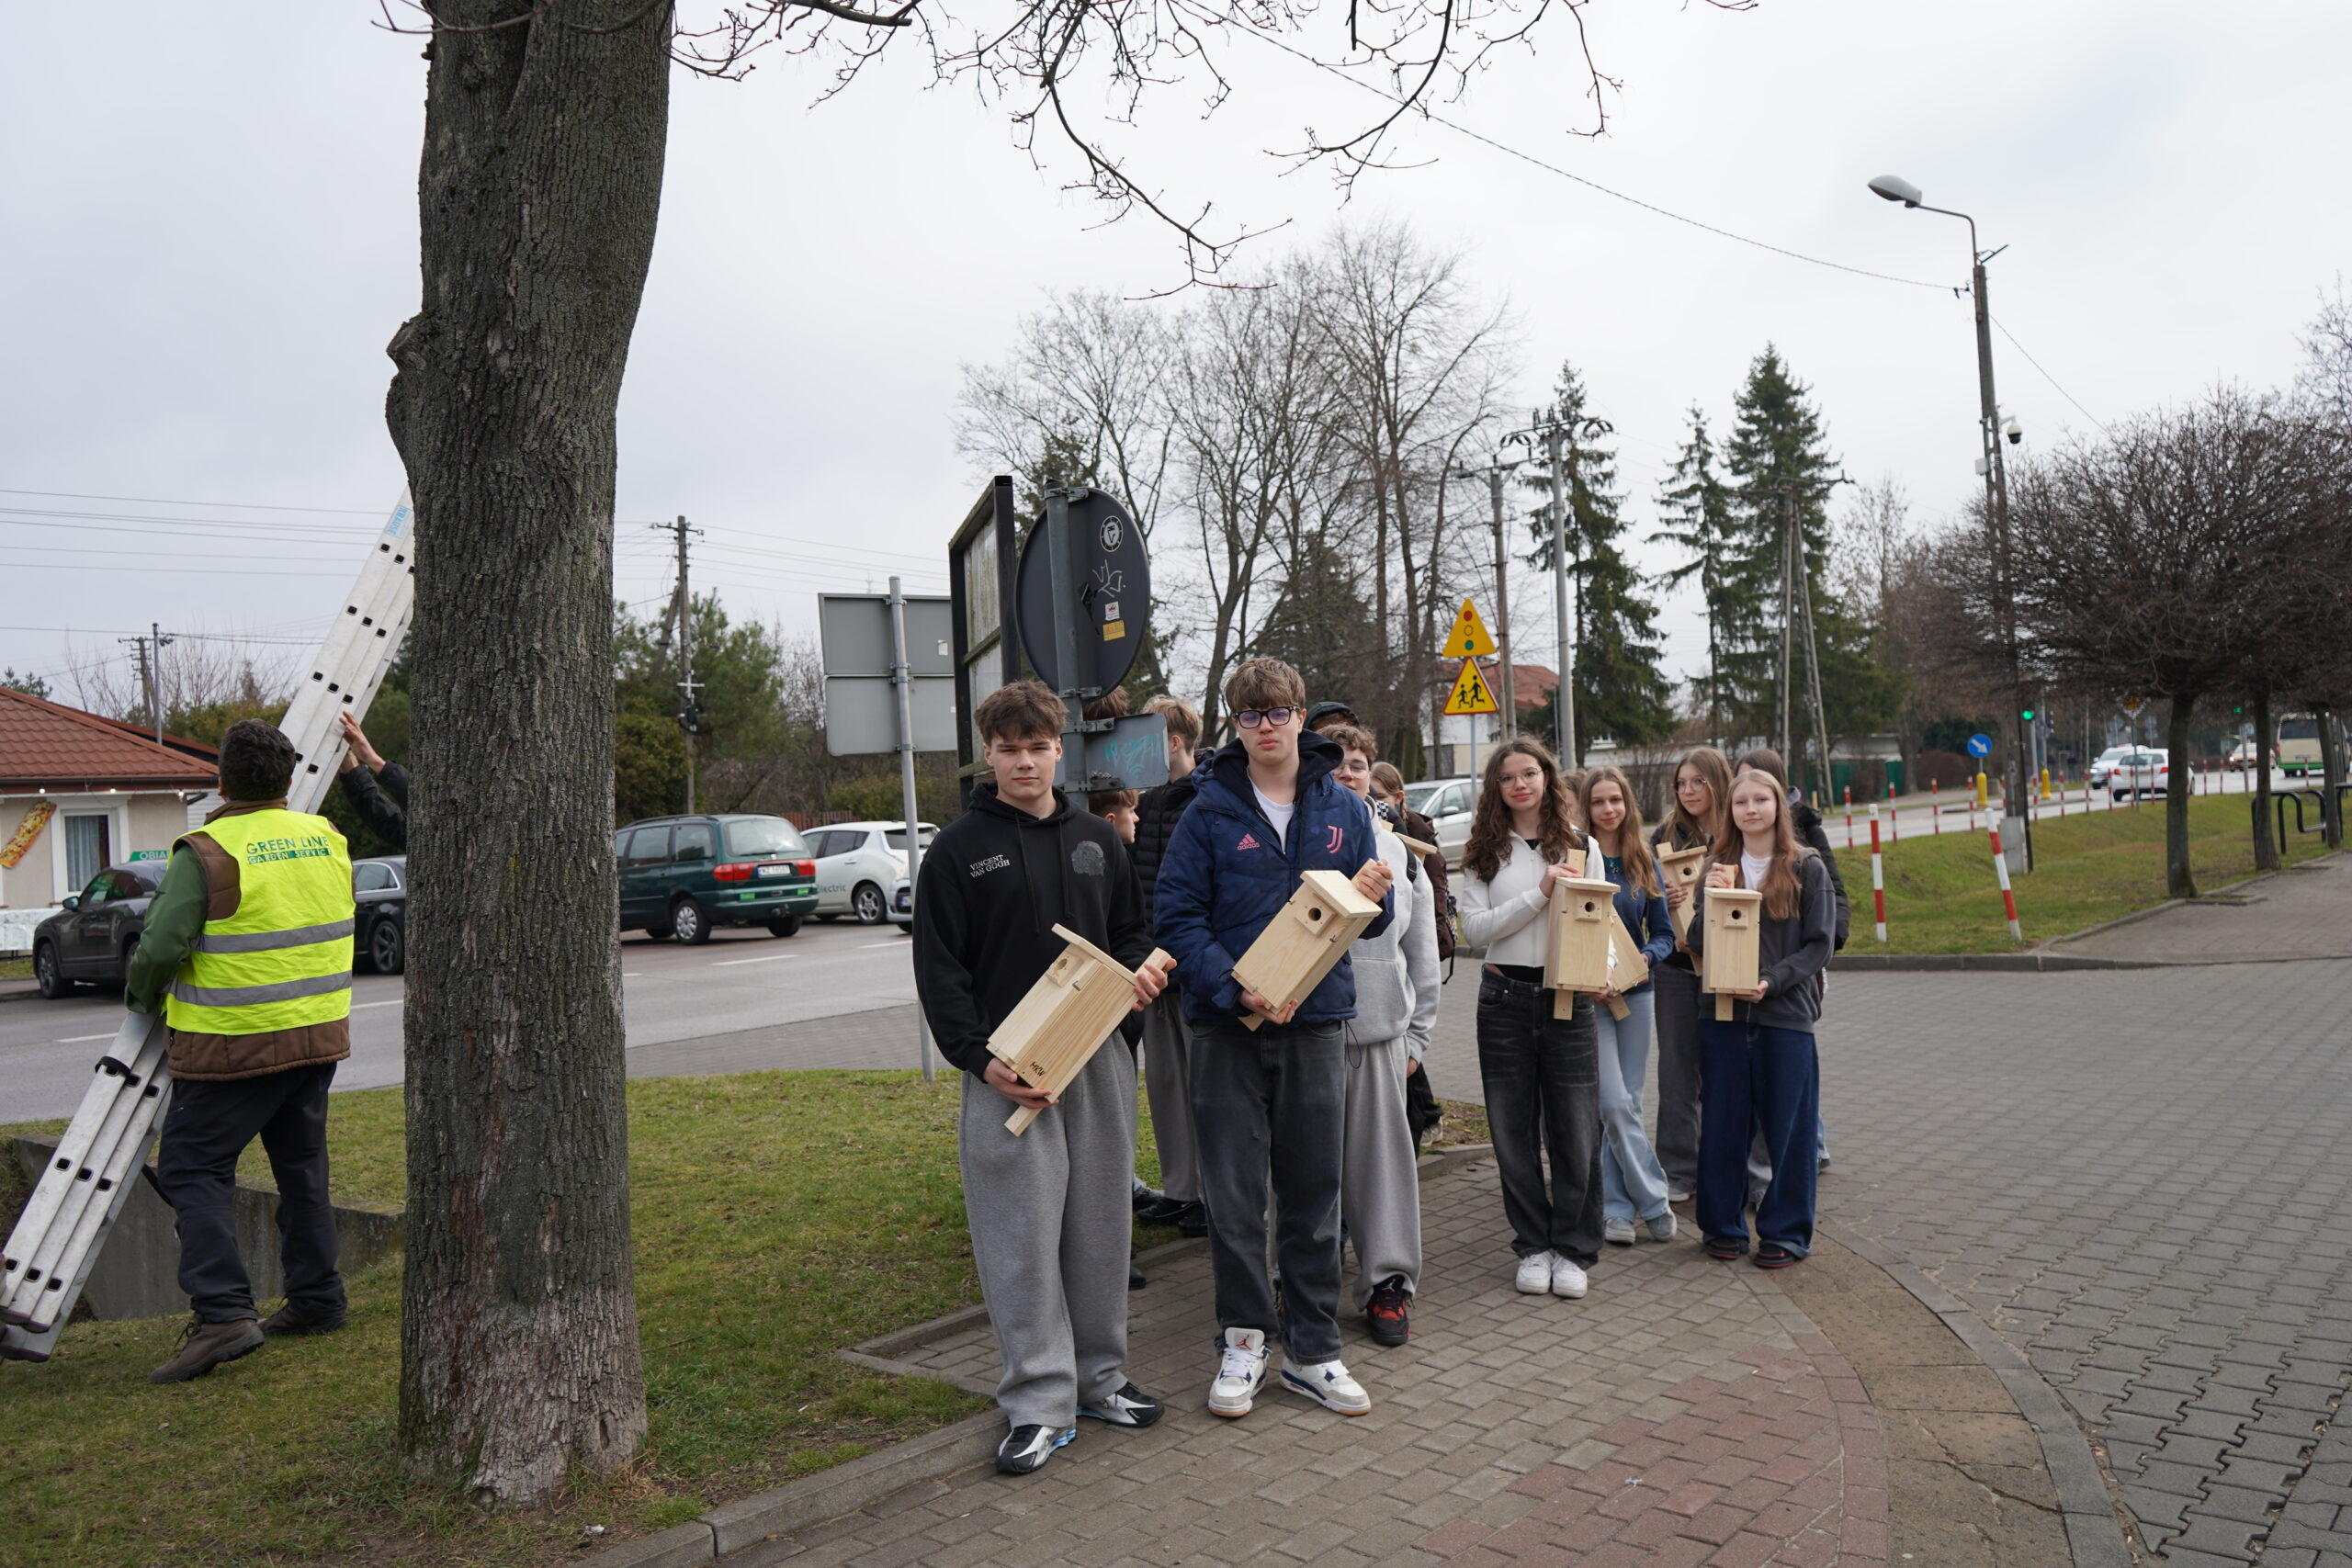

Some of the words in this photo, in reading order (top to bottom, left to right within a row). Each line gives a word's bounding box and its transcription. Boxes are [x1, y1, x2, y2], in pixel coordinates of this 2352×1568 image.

[246, 838, 296, 854] GREEN
[300, 836, 330, 848] LINE
[1237, 841, 1260, 851] adidas
[248, 851, 289, 864] GARDEN
[970, 854, 1003, 871] VINCENT
[970, 867, 985, 878] VAN
[985, 859, 1010, 872] GOGH
